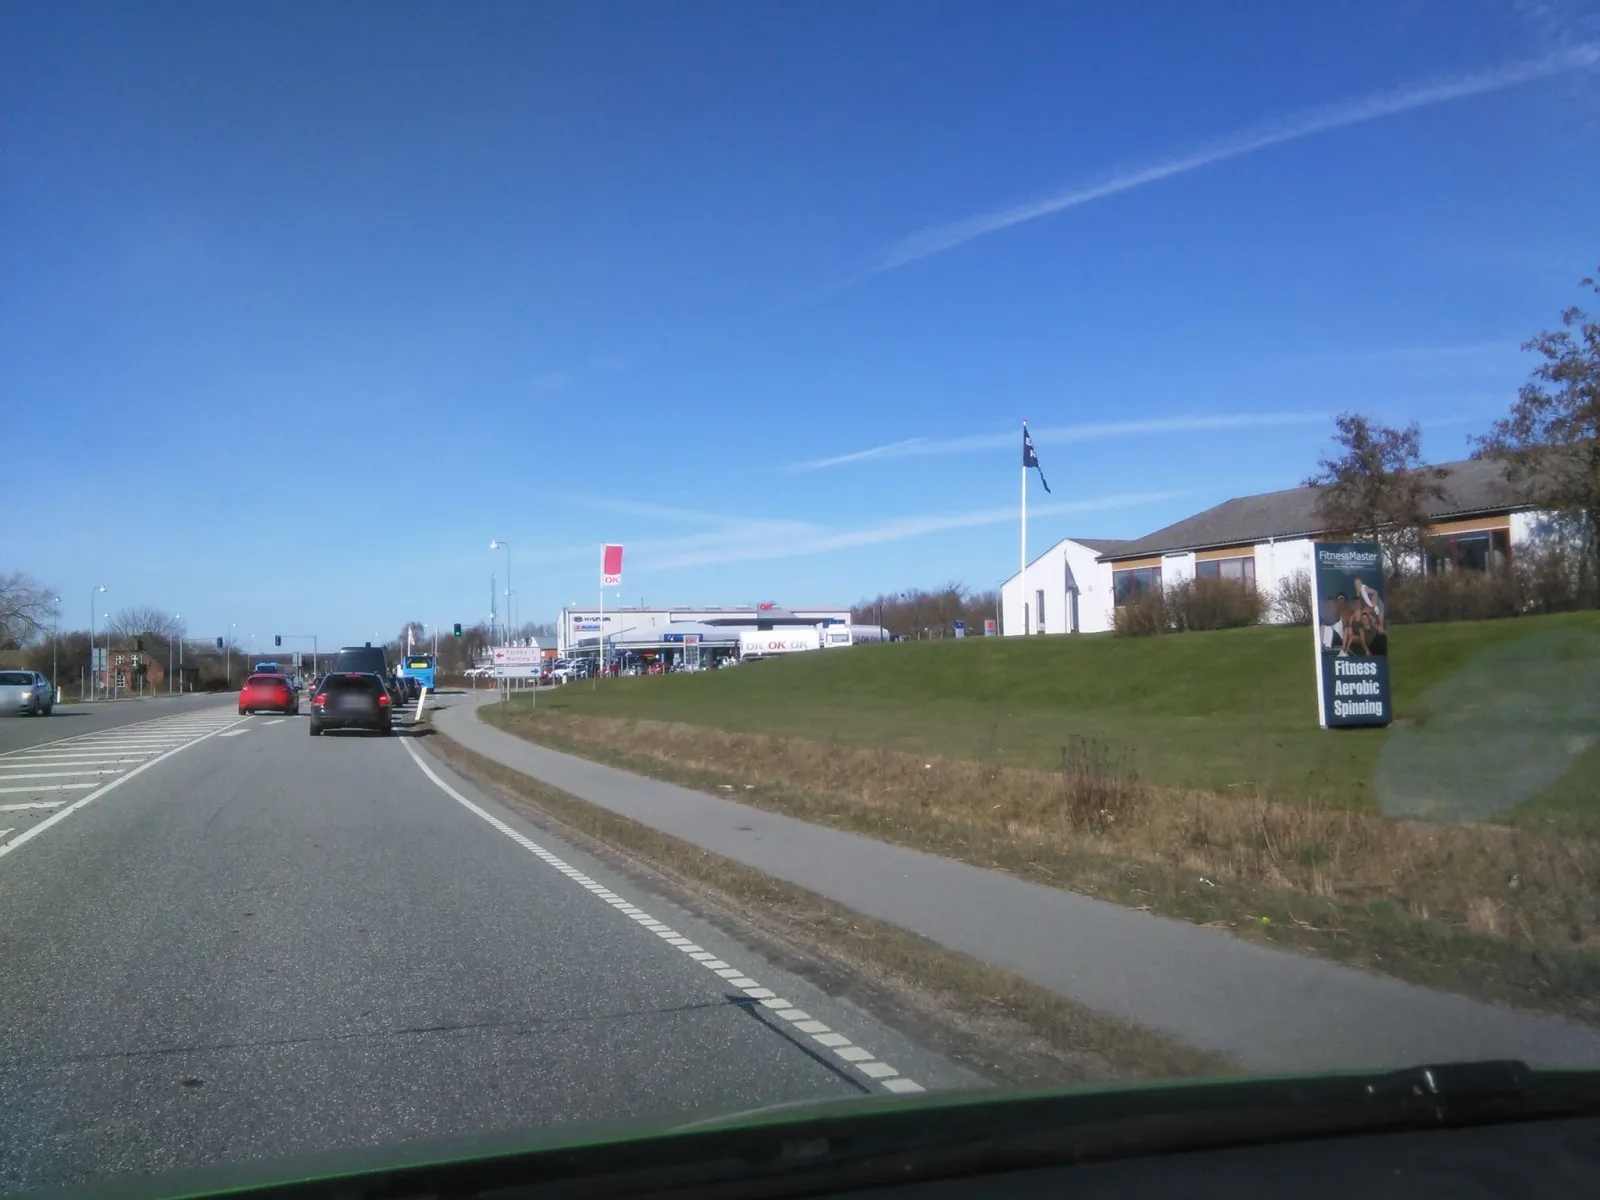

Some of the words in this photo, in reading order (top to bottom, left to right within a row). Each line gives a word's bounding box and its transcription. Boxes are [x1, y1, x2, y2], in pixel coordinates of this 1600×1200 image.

[1319, 550, 1378, 561] FitnessMaster
[605, 576, 620, 584] OK
[747, 642, 764, 651] OK
[768, 640, 786, 650] OK
[790, 639, 808, 649] OK
[1335, 660, 1377, 676] Fitness
[1335, 679, 1380, 696] Aerobic
[1334, 699, 1383, 718] Spinning
